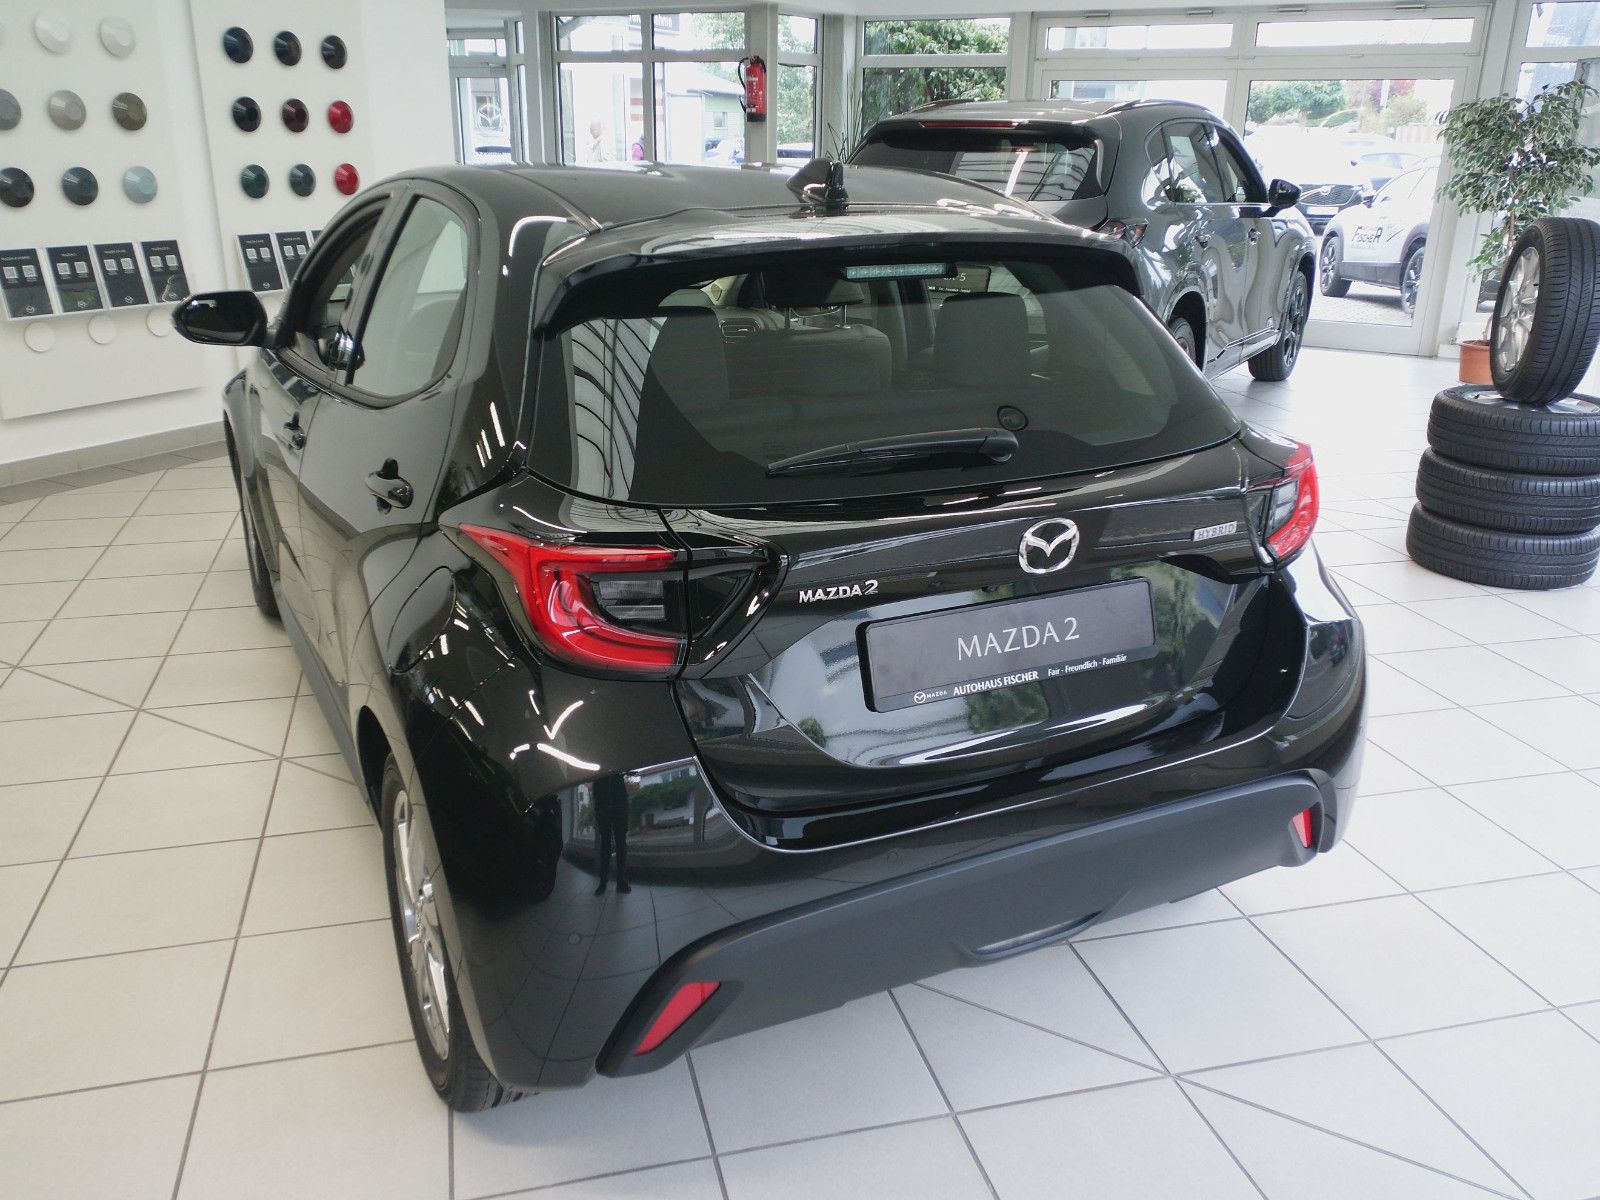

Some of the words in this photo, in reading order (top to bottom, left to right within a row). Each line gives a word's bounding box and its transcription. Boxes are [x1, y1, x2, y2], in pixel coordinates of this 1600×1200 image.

[1197, 523, 1235, 539] HYBRID
[1048, 668, 1060, 677] Fair
[1065, 660, 1098, 674] Freundlich
[926, 690, 948, 699] MAZDA
[953, 678, 1002, 696] AUTOHAUS
[1003, 671, 1039, 686] FISCHER
